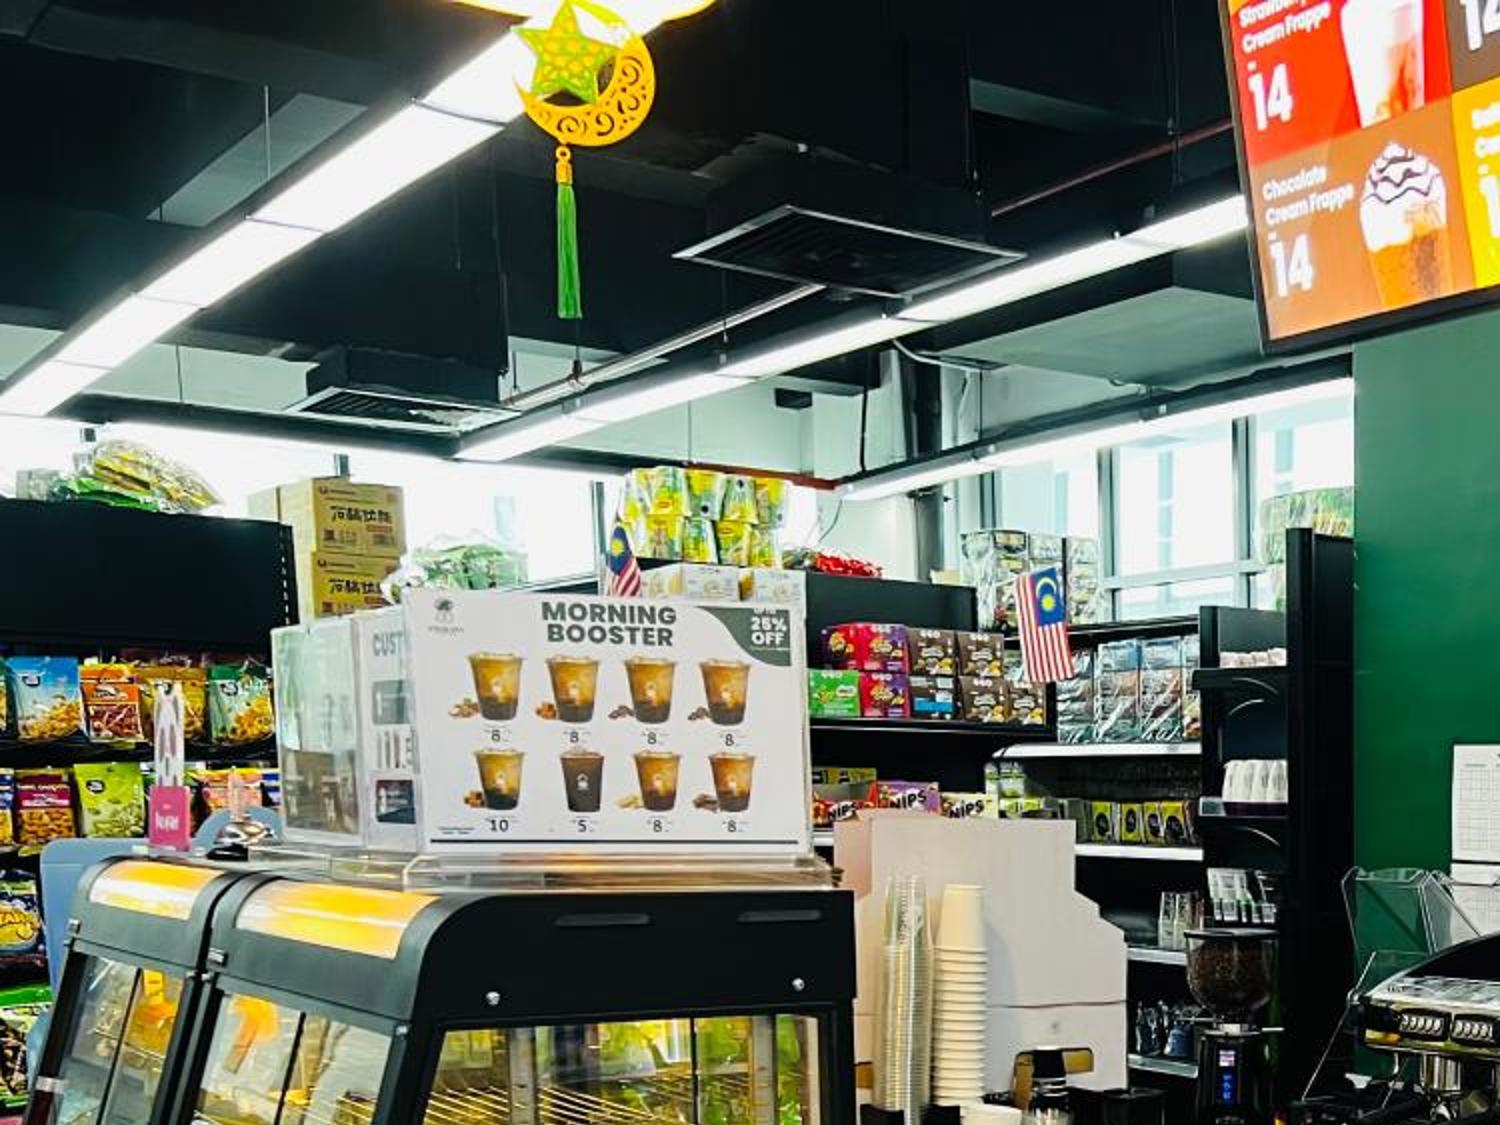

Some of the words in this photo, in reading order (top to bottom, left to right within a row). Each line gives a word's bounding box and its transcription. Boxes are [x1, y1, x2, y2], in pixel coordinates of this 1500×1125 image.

[1248, 62, 1294, 131] 14
[1270, 234, 1313, 298] 14
[541, 601, 677, 625] MORNING
[751, 616, 787, 632] 25%
[547, 624, 673, 647] BOOSTER
[751, 631, 785, 646] OFF
[950, 799, 985, 818] NIPS
[490, 819, 509, 832] 10
[578, 819, 587, 832] 5
[653, 820, 662, 832] 8
[728, 820, 737, 832] 8
